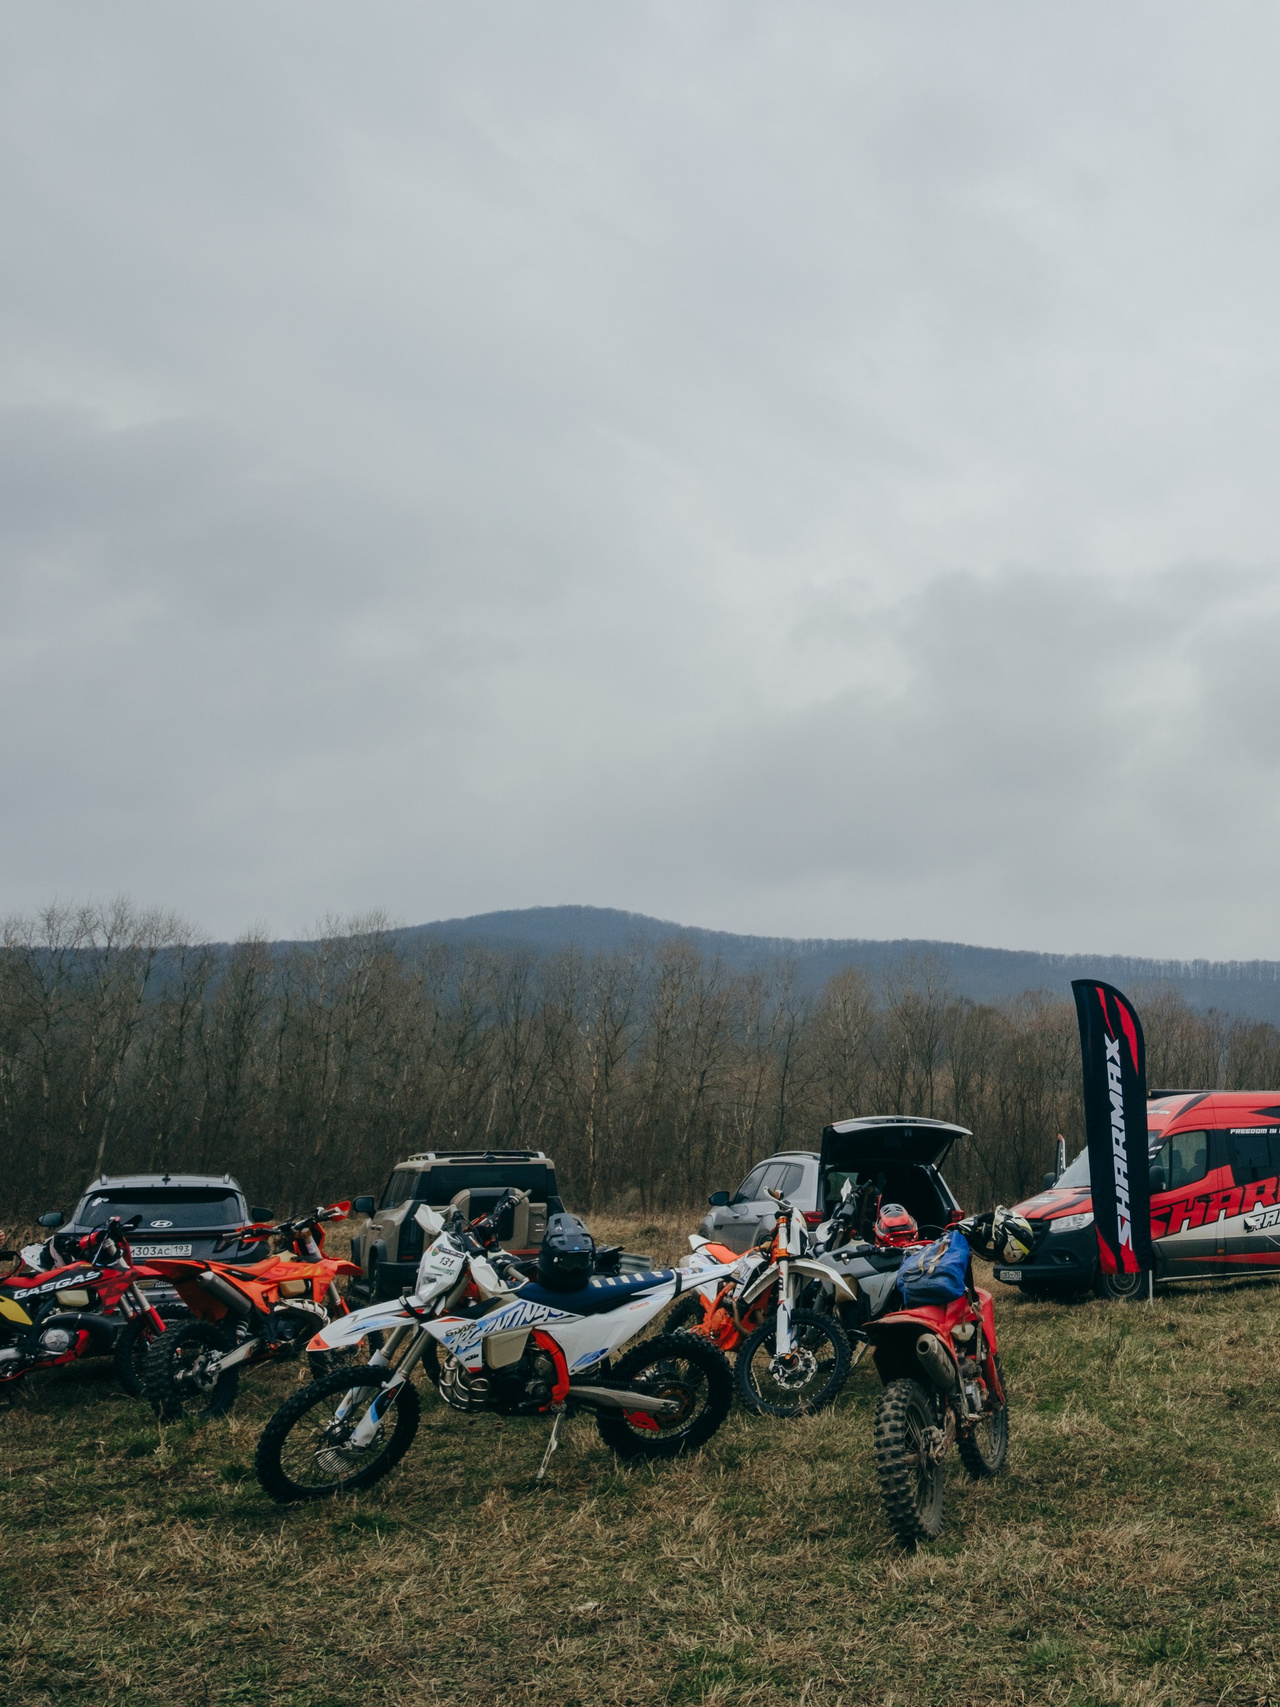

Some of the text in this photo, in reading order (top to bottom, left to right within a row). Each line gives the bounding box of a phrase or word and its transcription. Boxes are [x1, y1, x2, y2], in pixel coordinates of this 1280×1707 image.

[1103, 1032, 1133, 1252] SHARMAX
[439, 1256, 455, 1267] 131
[12, 1271, 101, 1300] GASGAS
[464, 1353, 479, 1362] KTM
